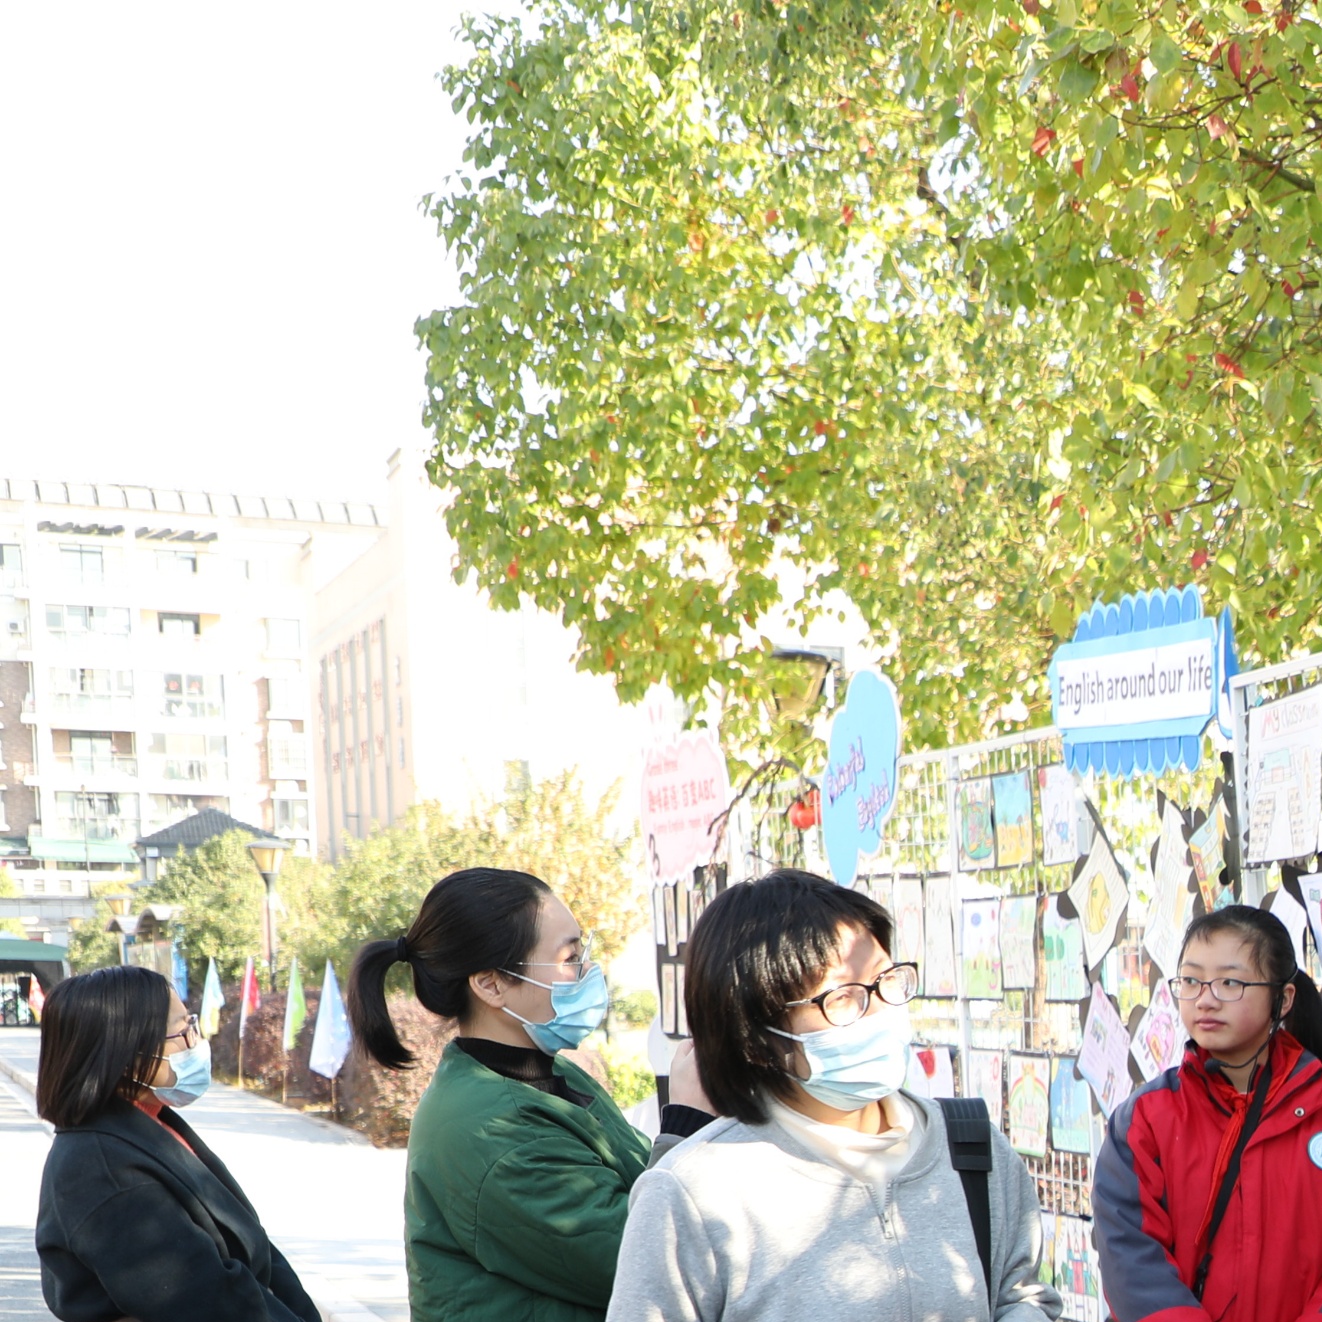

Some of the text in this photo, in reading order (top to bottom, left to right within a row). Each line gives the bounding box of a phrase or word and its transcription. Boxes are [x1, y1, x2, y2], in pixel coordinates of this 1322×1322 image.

[1058, 655, 1212, 715] English around our life
